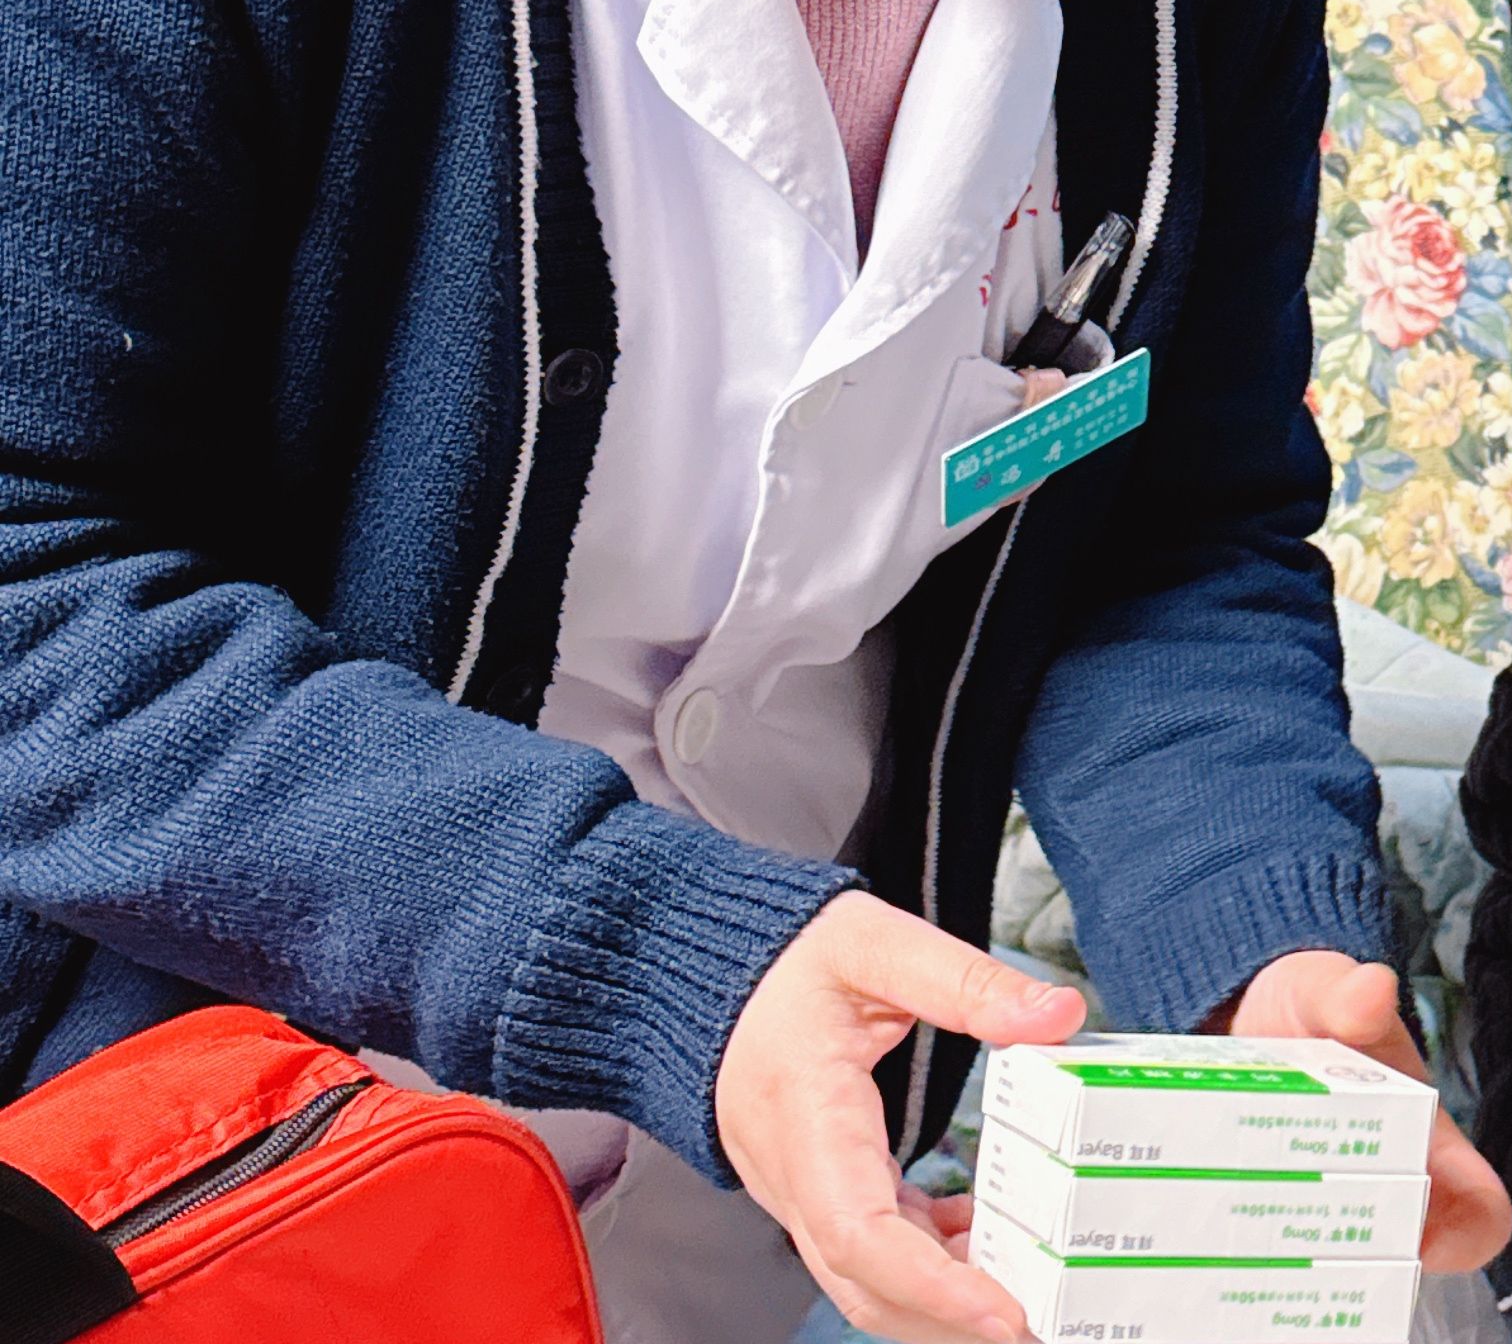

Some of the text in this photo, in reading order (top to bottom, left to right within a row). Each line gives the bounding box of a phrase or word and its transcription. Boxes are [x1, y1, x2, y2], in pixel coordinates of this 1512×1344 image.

[1077, 1142, 1123, 1161] Bayer
[1069, 1232, 1114, 1251] Bayer
[1058, 1323, 1104, 1340] Bayer
